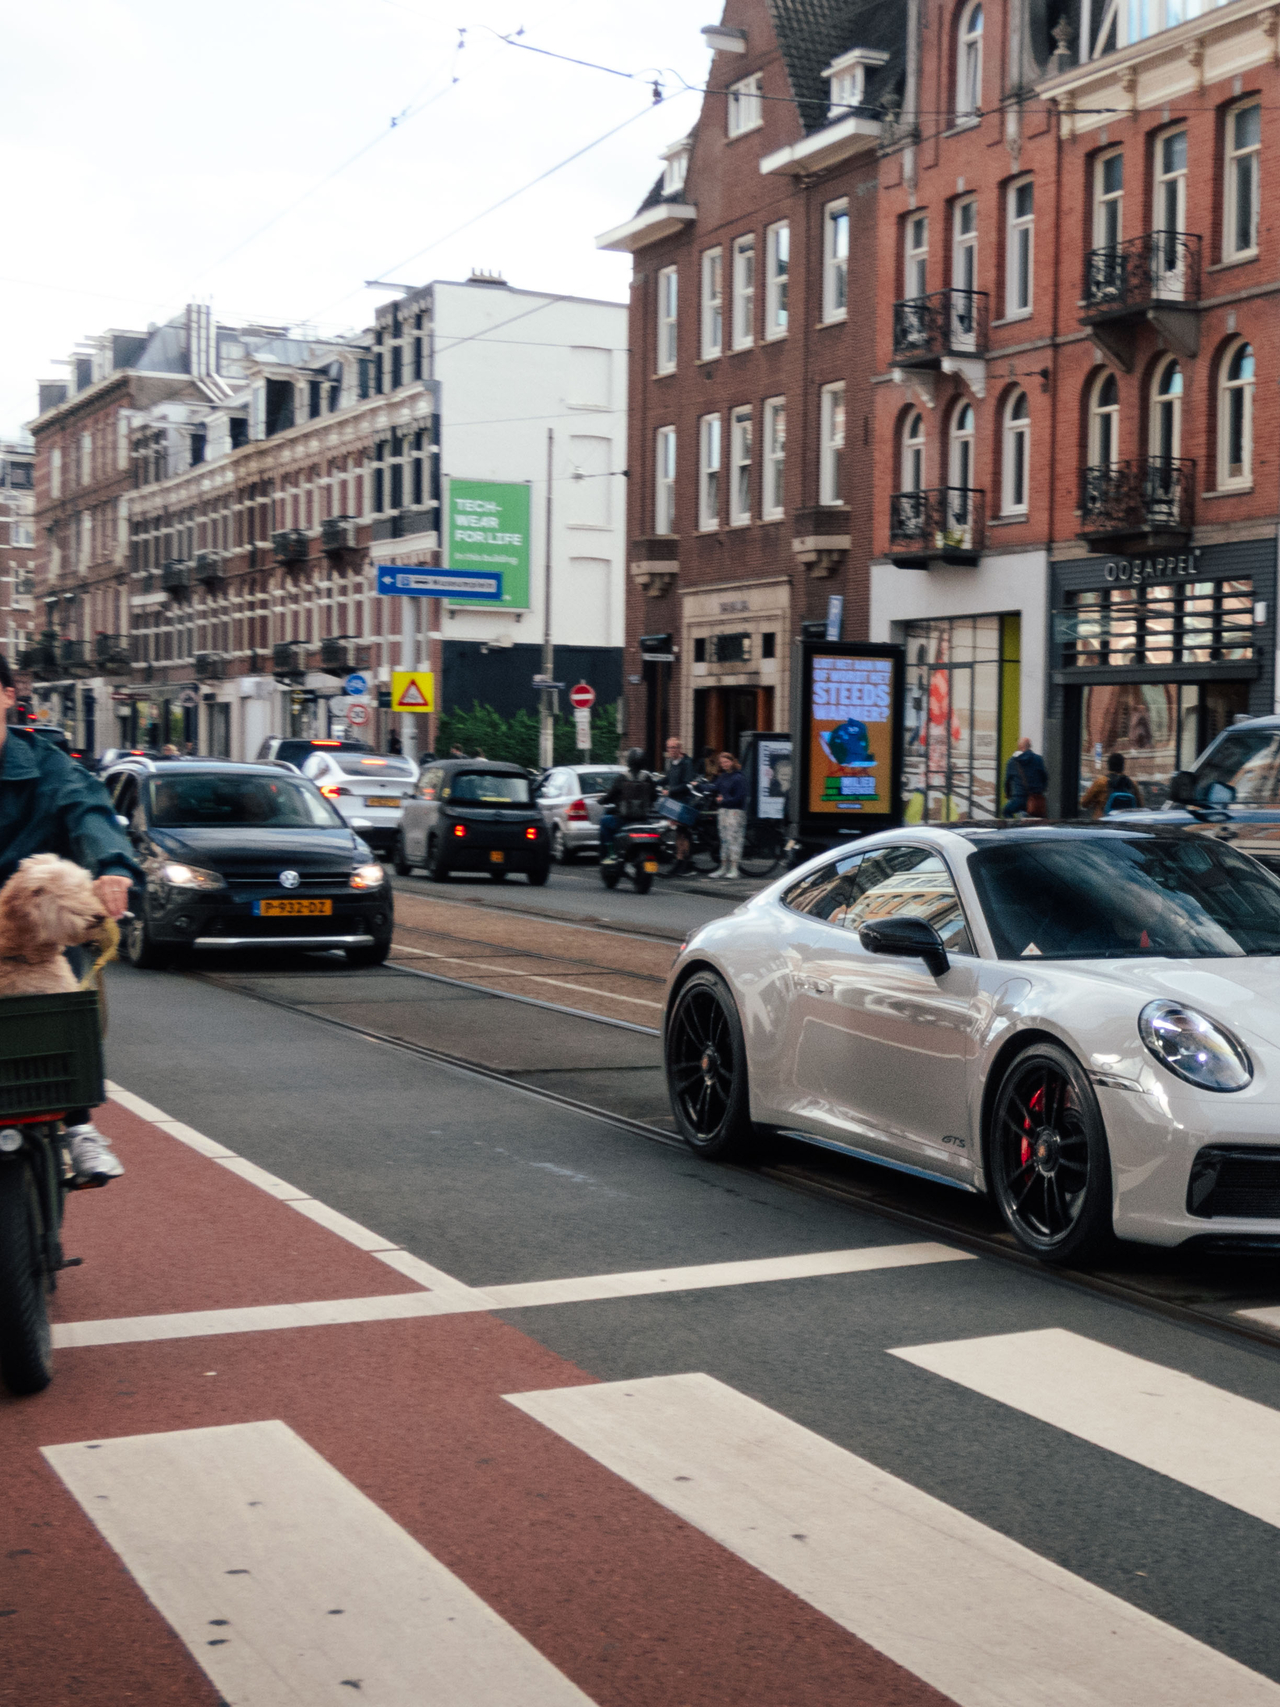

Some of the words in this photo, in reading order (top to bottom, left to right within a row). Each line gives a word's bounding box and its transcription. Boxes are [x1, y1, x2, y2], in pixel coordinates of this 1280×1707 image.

[454, 499, 503, 513] TECH-
[454, 514, 499, 528] WEAR
[454, 530, 486, 543] FOR
[487, 532, 523, 546] LIFE
[813, 681, 891, 706] STEEDS
[265, 901, 326, 914] P-932-DZ
[941, 1135, 966, 1148] GTS
